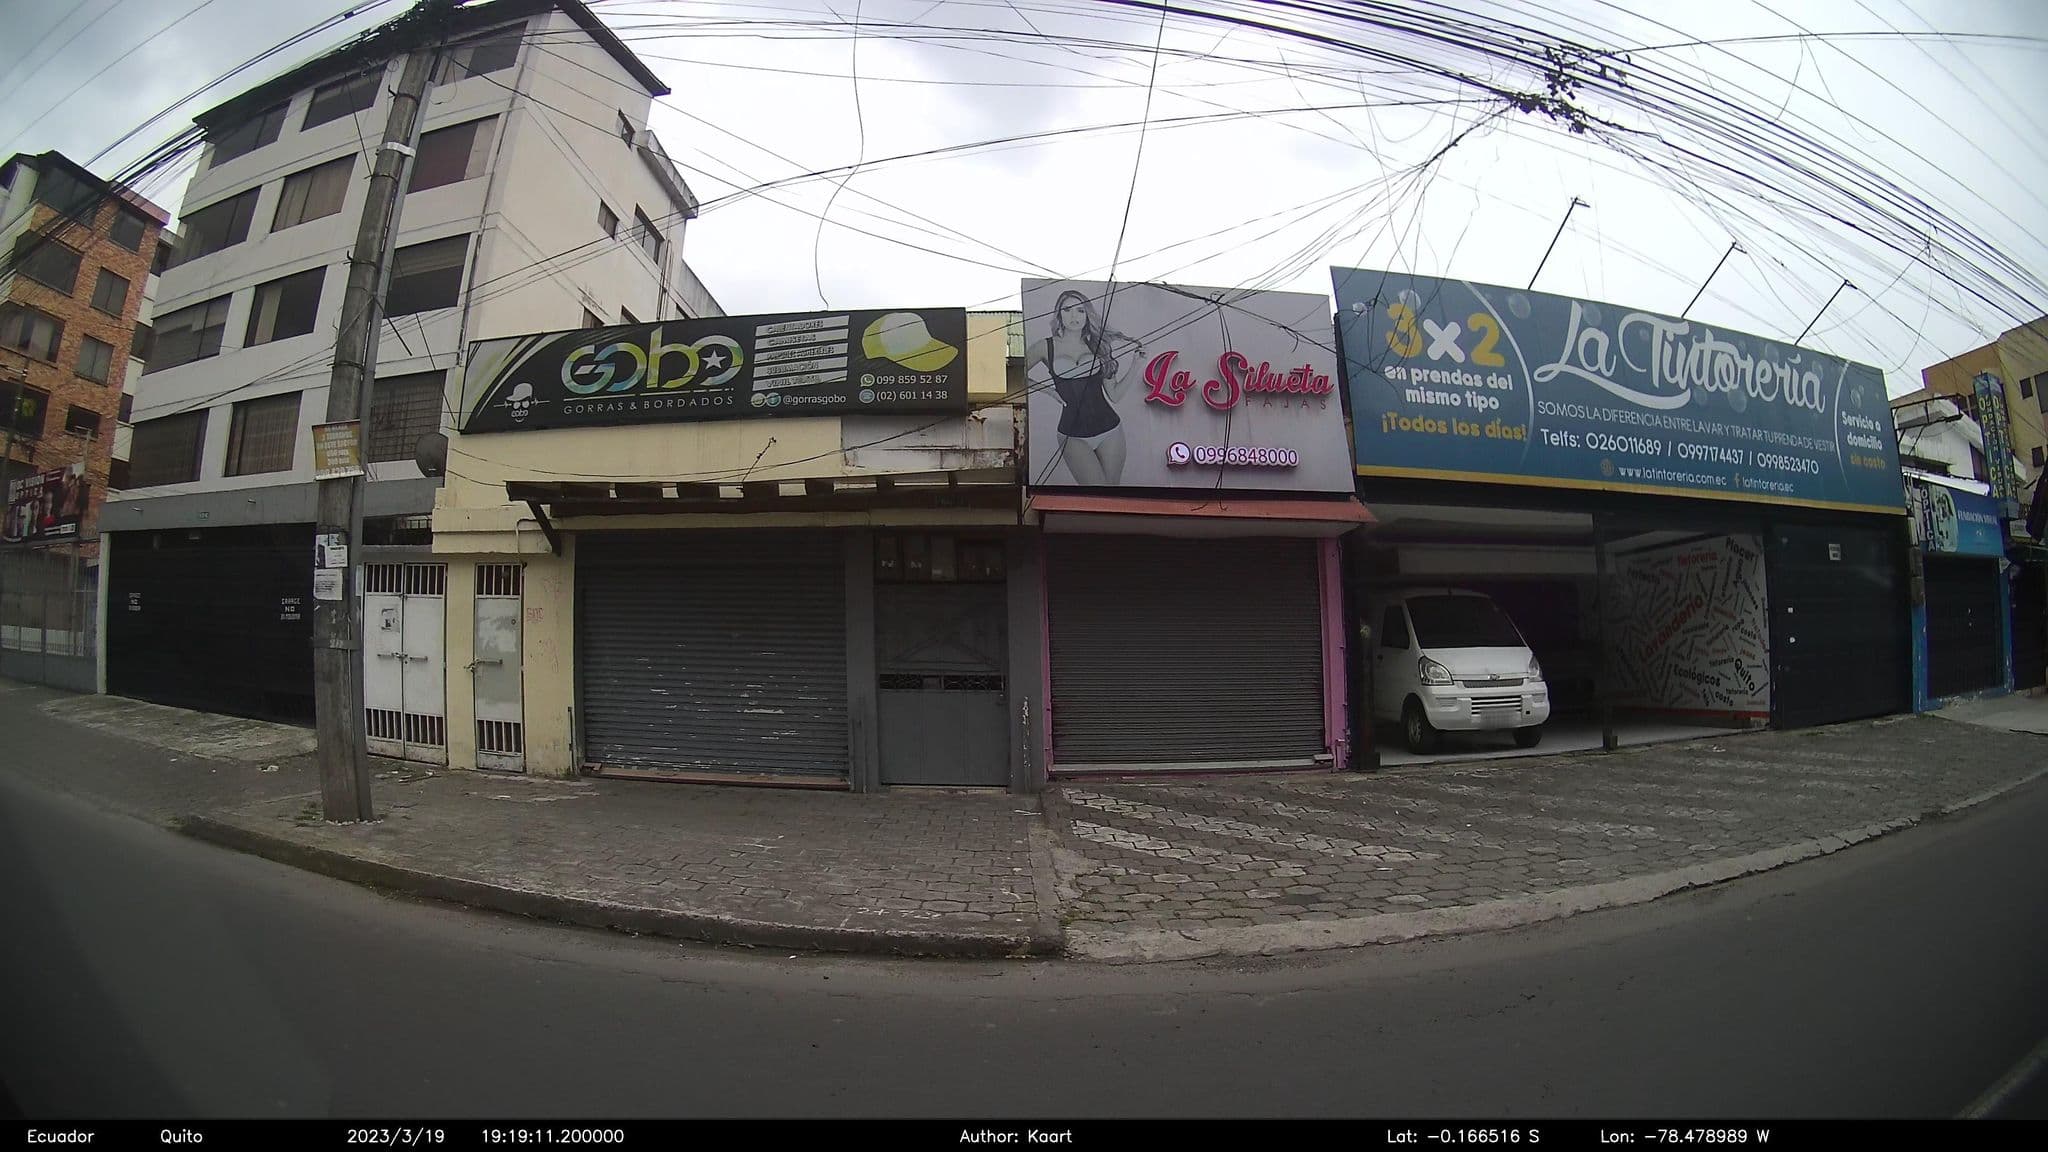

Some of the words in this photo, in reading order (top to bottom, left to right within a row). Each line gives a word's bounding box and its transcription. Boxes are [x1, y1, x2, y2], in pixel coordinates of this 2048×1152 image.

[1618, 312, 1826, 413] Tintorería
[876, 375, 895, 385] 099
[898, 375, 917, 384] 859
[920, 374, 932, 384] 52
[935, 374, 948, 384] 87
[1143, 351, 1197, 408] La
[1202, 351, 1335, 411] Silueta
[1384, 365, 1407, 380] en
[1410, 367, 1483, 387] prendas
[1487, 372, 1513, 390] del
[563, 402, 624, 415] GORRAS
[629, 401, 637, 410] &
[644, 396, 733, 410] BORDADOS
[783, 394, 847, 405] @gorrasgobo
[876, 391, 897, 402] (02)
[899, 391, 917, 400] 601
[921, 391, 932, 400] 14
[935, 390, 948, 400] 38
[1245, 399, 1328, 410] FAJAS
[1405, 386, 1461, 406] mismo
[1465, 390, 1500, 413] tipo
[1382, 411, 1448, 434] ¡Todos
[1452, 417, 1481, 436] los
[1537, 401, 1585, 419] SOMOS
[1586, 405, 1602, 420] LA
[1602, 408, 1662, 427] DIFERENCIA
[1663, 415, 1692, 432] ENTRE
[1692, 420, 1724, 436] LAVAR
[1731, 425, 1763, 441] TRATAR
[1773, 431, 1803, 448] PRENDA
[1802, 436, 1814, 450] DE
[1841, 411, 1874, 430] Servicio
[1540, 428, 1580, 448] Telfs:
[1585, 432, 1662, 456] 026011689
[1677, 443, 1744, 465] 0997174437
[1757, 452, 1819, 474] 0998523470
[1847, 432, 1883, 451] domicilio
[1194, 446, 1299, 466] 0996848000
[1619, 466, 1728, 486] www.latintoreria.com.ec
[1734, 658, 1755, 691] Quito
